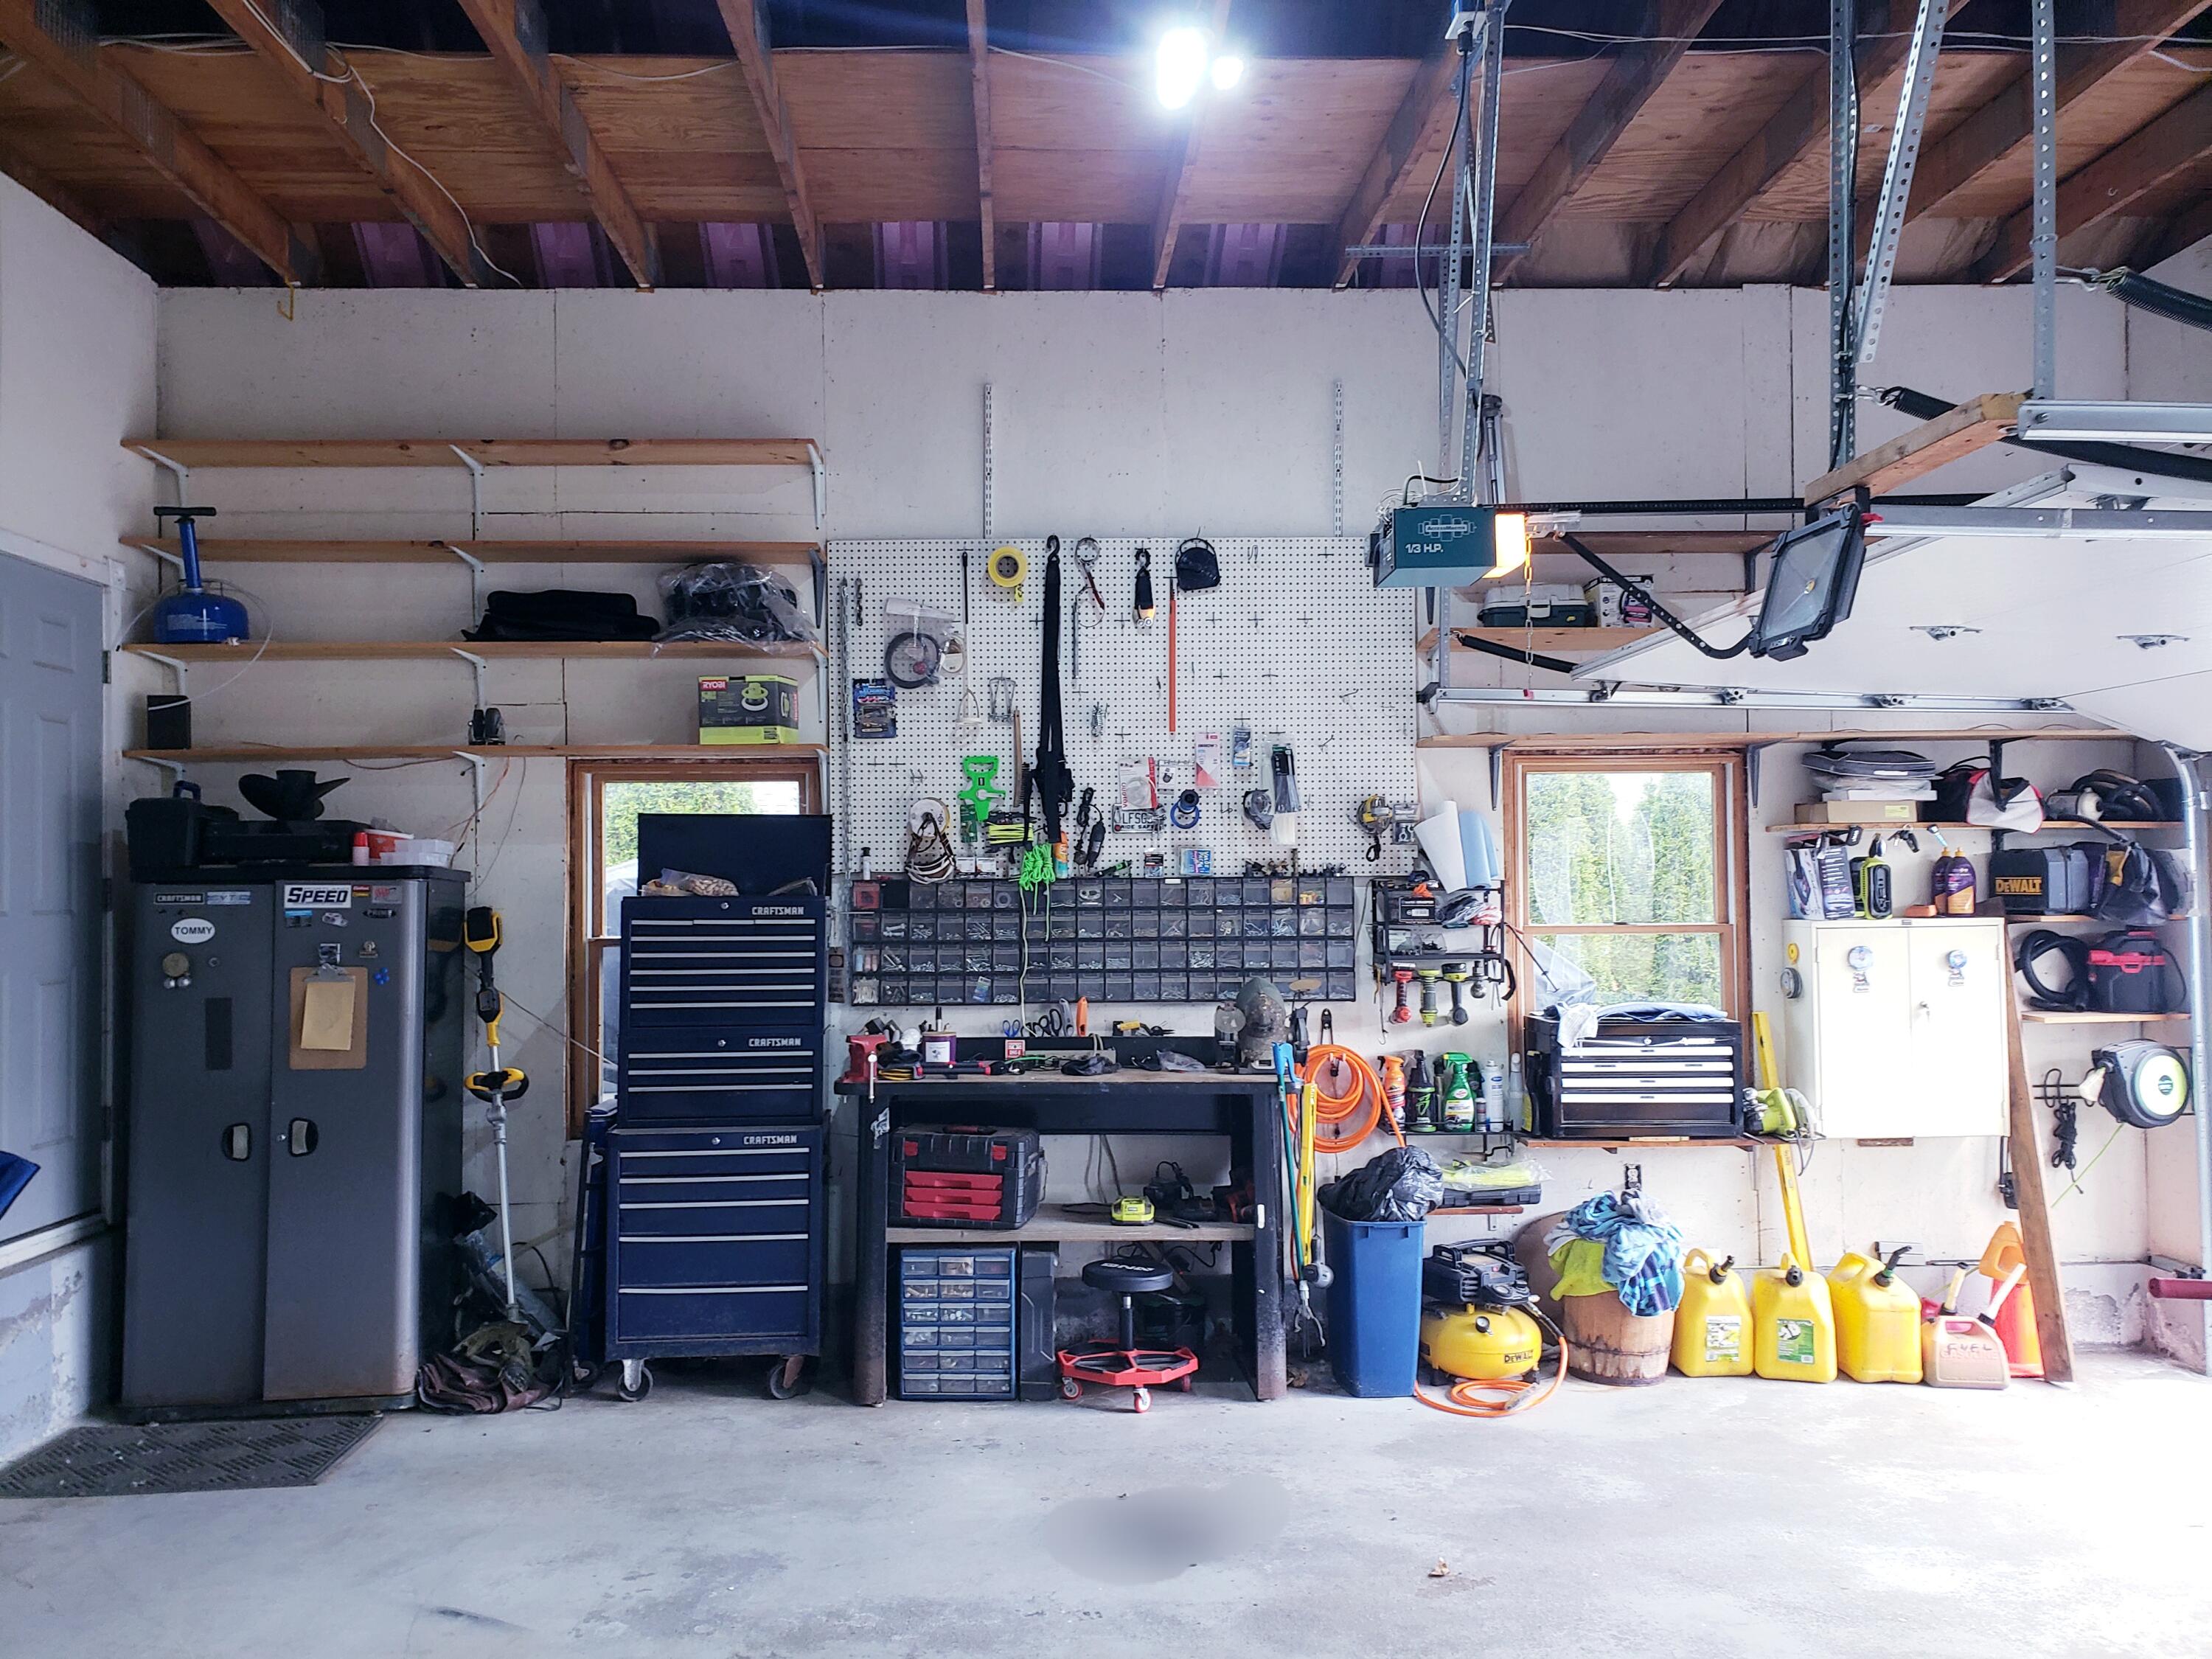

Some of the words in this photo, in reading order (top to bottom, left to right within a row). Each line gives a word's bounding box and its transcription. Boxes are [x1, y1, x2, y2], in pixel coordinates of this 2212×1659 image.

[1405, 543, 1421, 553] 1/3
[1423, 543, 1444, 553] H.P.
[1995, 879, 2042, 892] DEWALT
[287, 887, 349, 902] SPEED
[752, 907, 804, 915] CRAFTSMAN
[175, 927, 212, 935] TOMMY
[748, 1038, 801, 1047] CRAFTSMAN
[743, 1135, 797, 1145] CRAFTSMAN
